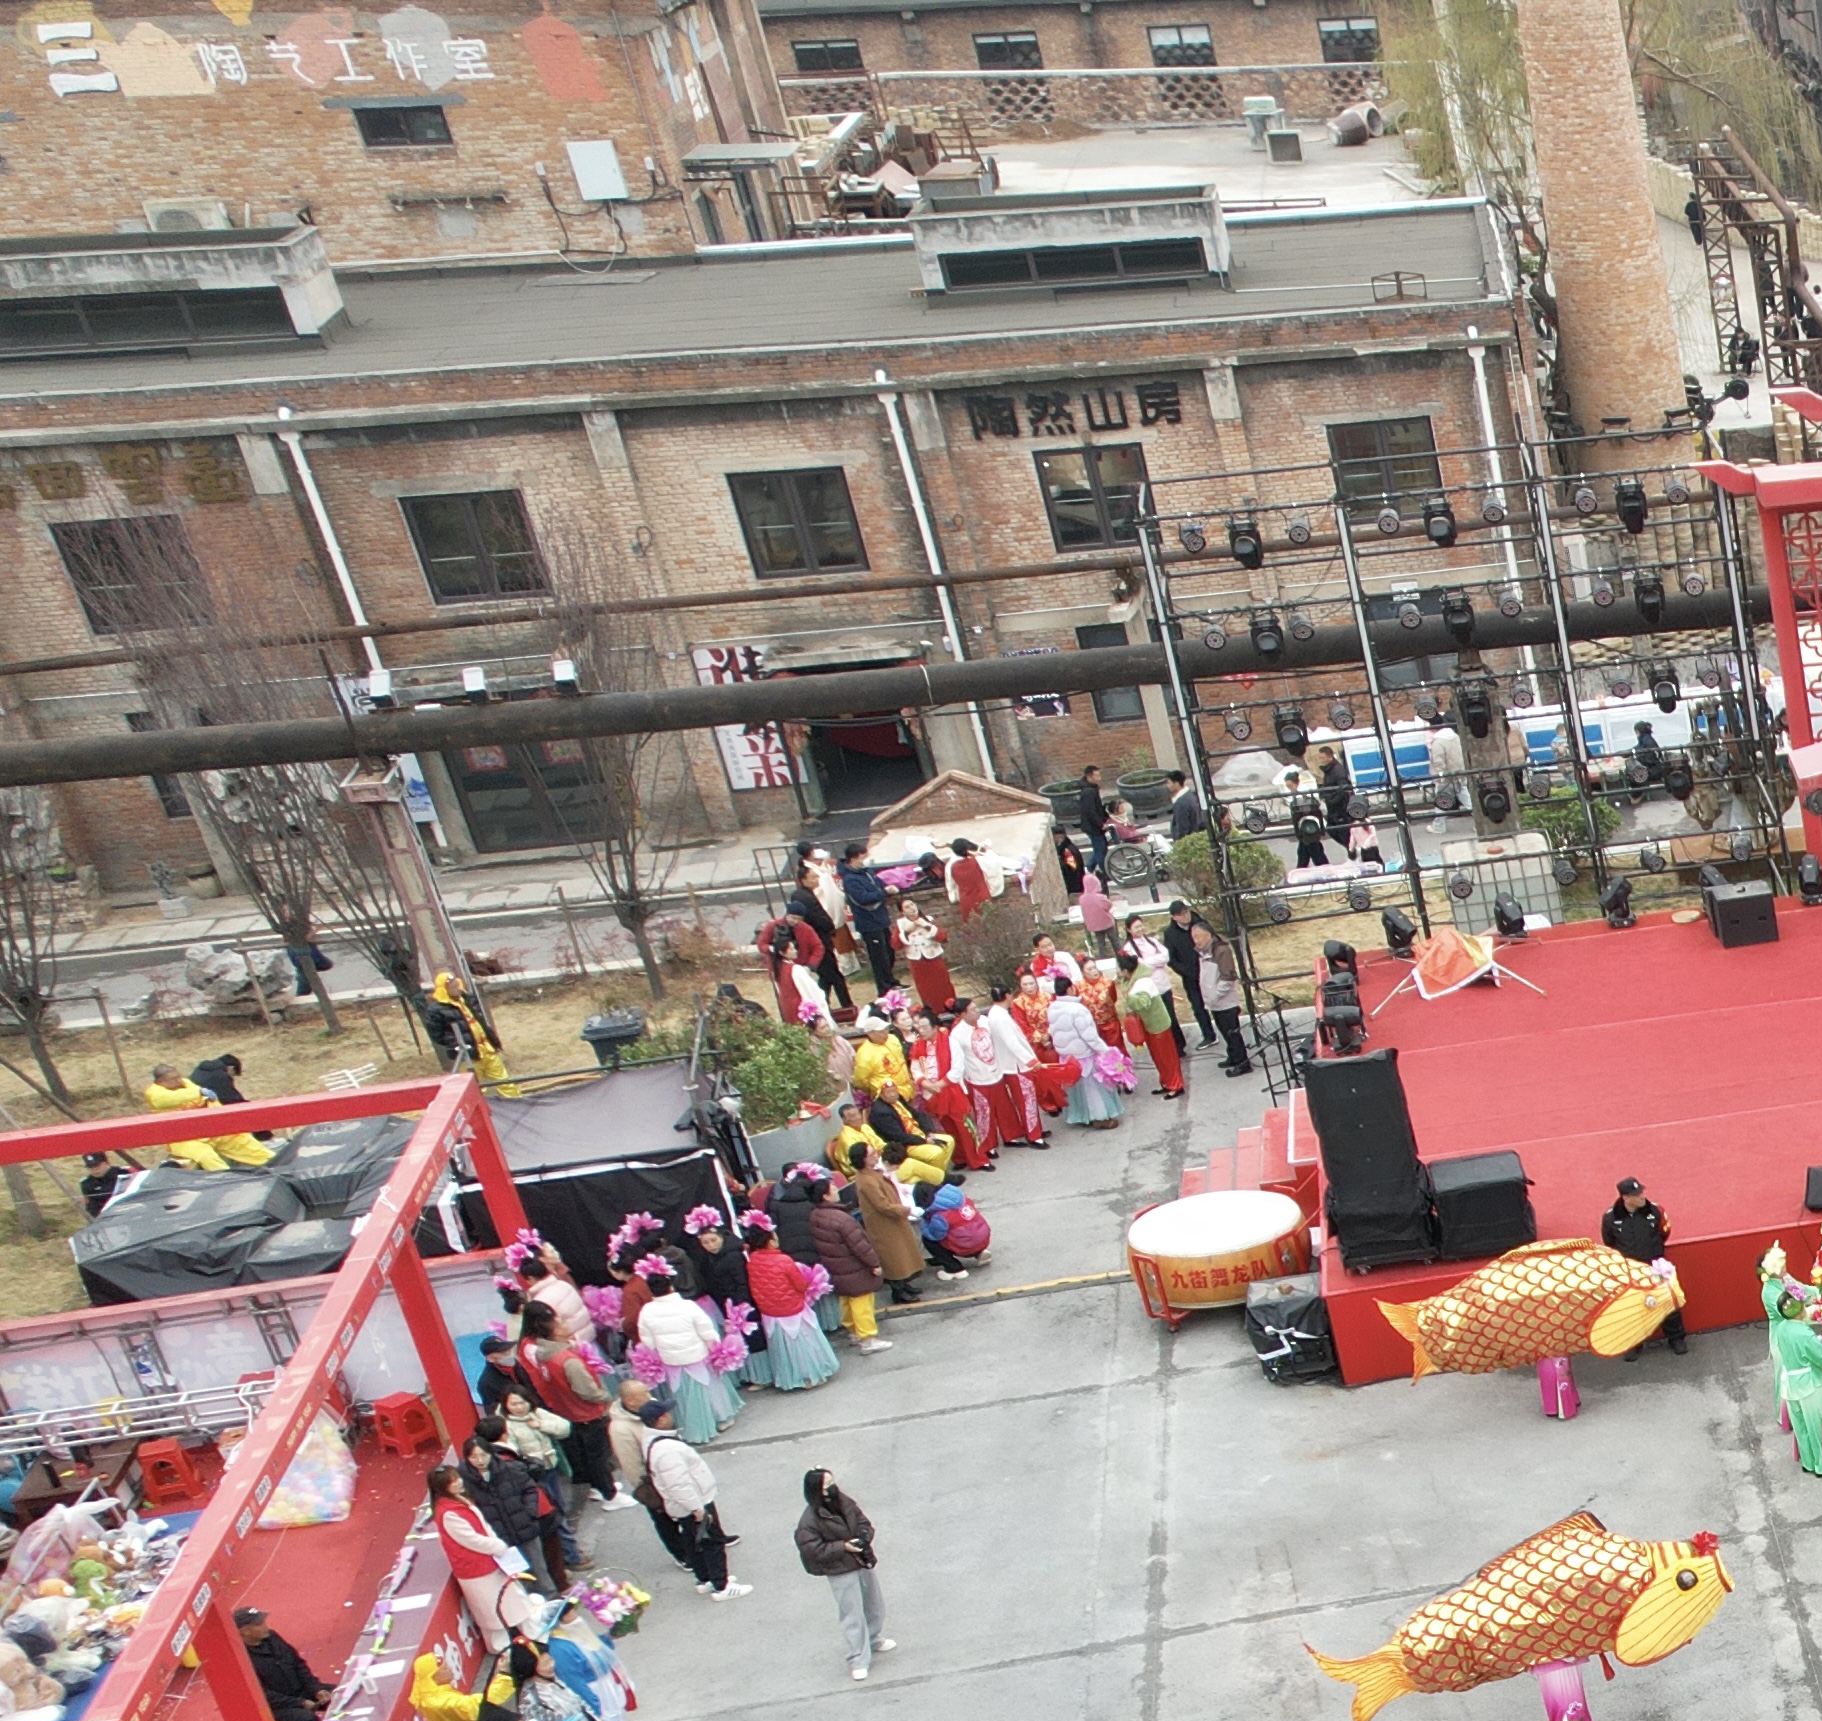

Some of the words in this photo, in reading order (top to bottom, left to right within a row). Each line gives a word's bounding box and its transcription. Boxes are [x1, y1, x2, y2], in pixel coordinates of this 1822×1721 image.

[197, 37, 496, 86] 陶艺工作室
[967, 381, 1184, 440] 陶然山房
[1170, 1260, 1271, 1290] 九街舞龙队
